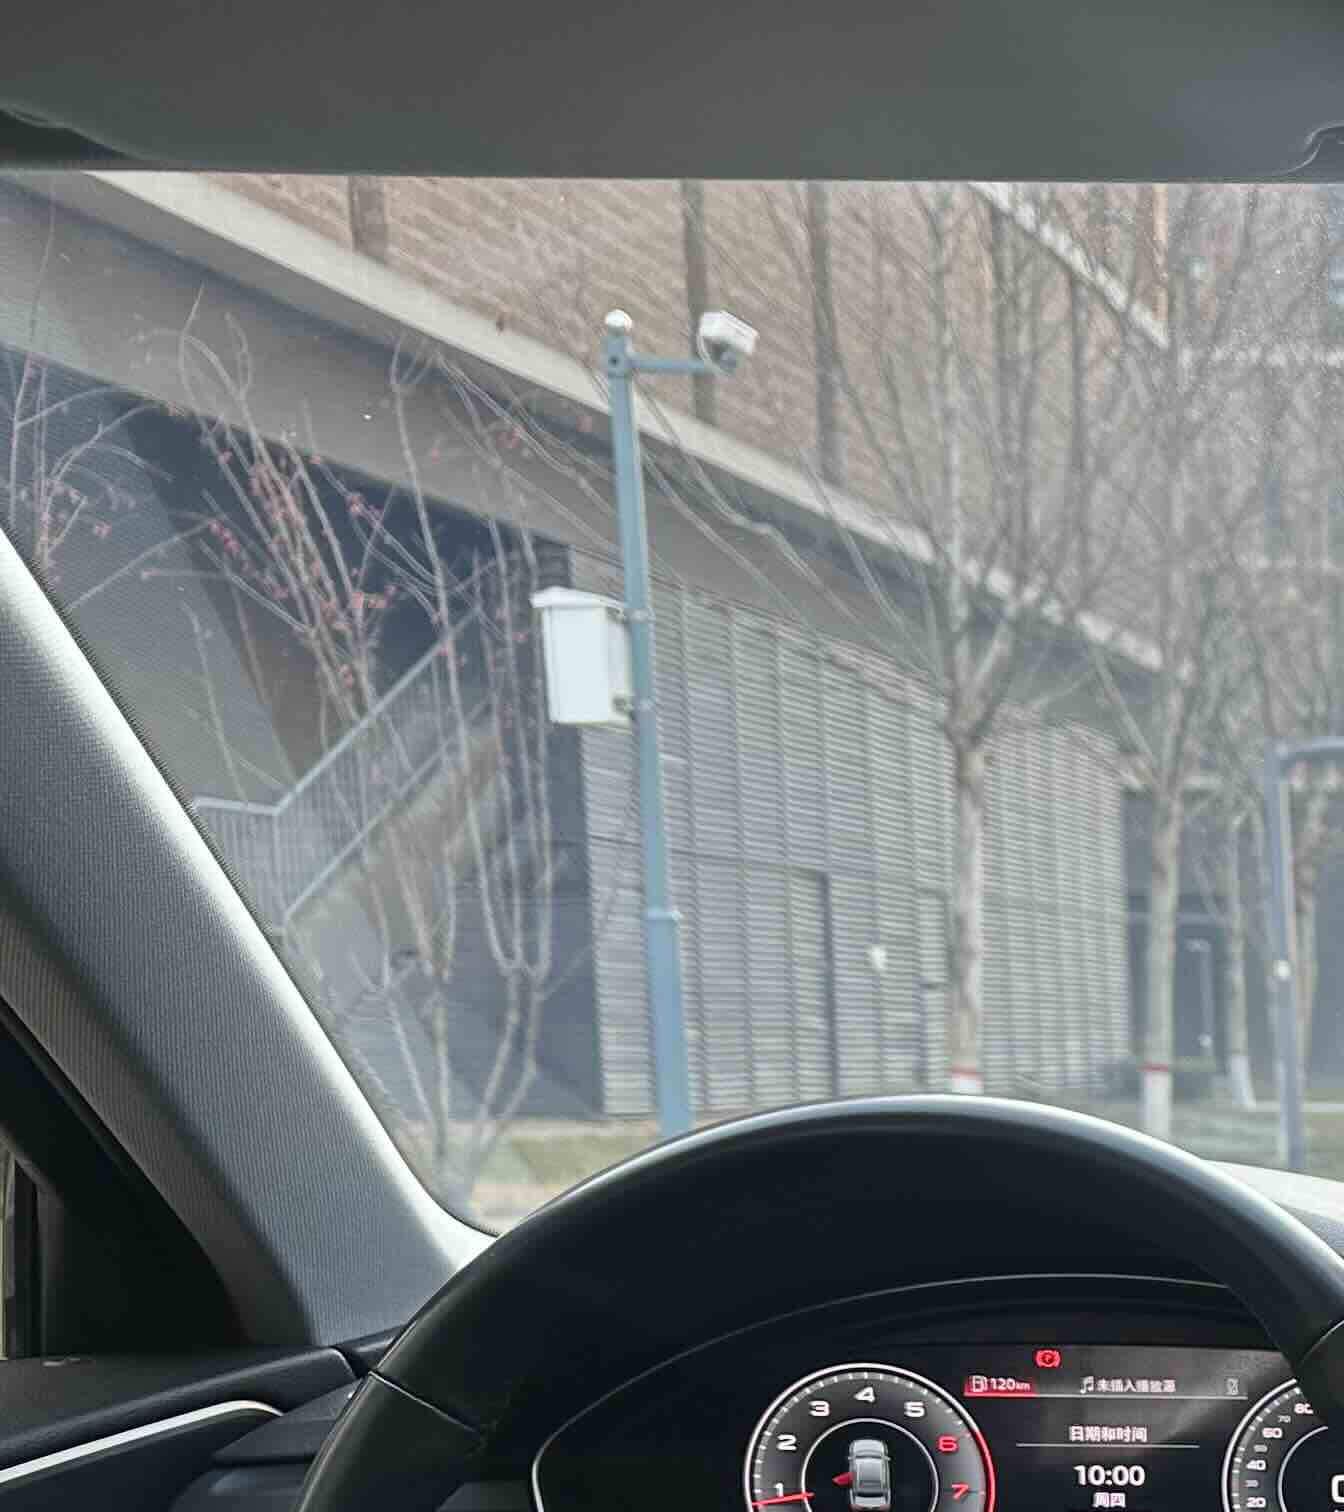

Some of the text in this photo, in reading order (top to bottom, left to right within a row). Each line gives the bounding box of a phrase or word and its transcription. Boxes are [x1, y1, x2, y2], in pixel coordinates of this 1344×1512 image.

[854, 1387, 875, 1402] 4
[809, 1400, 830, 1417] 3
[904, 1402, 925, 1417] 5
[1069, 1426, 1148, 1442] 日期和时间
[777, 1434, 797, 1451] 2
[938, 1436, 959, 1452] 6
[1074, 1465, 1145, 1486] 10:00
[775, 1483, 784, 1497] 1
[951, 1484, 969, 1500] 7
[1093, 1492, 1125, 1508] 周四
[1246, 1497, 1266, 1508] 20
